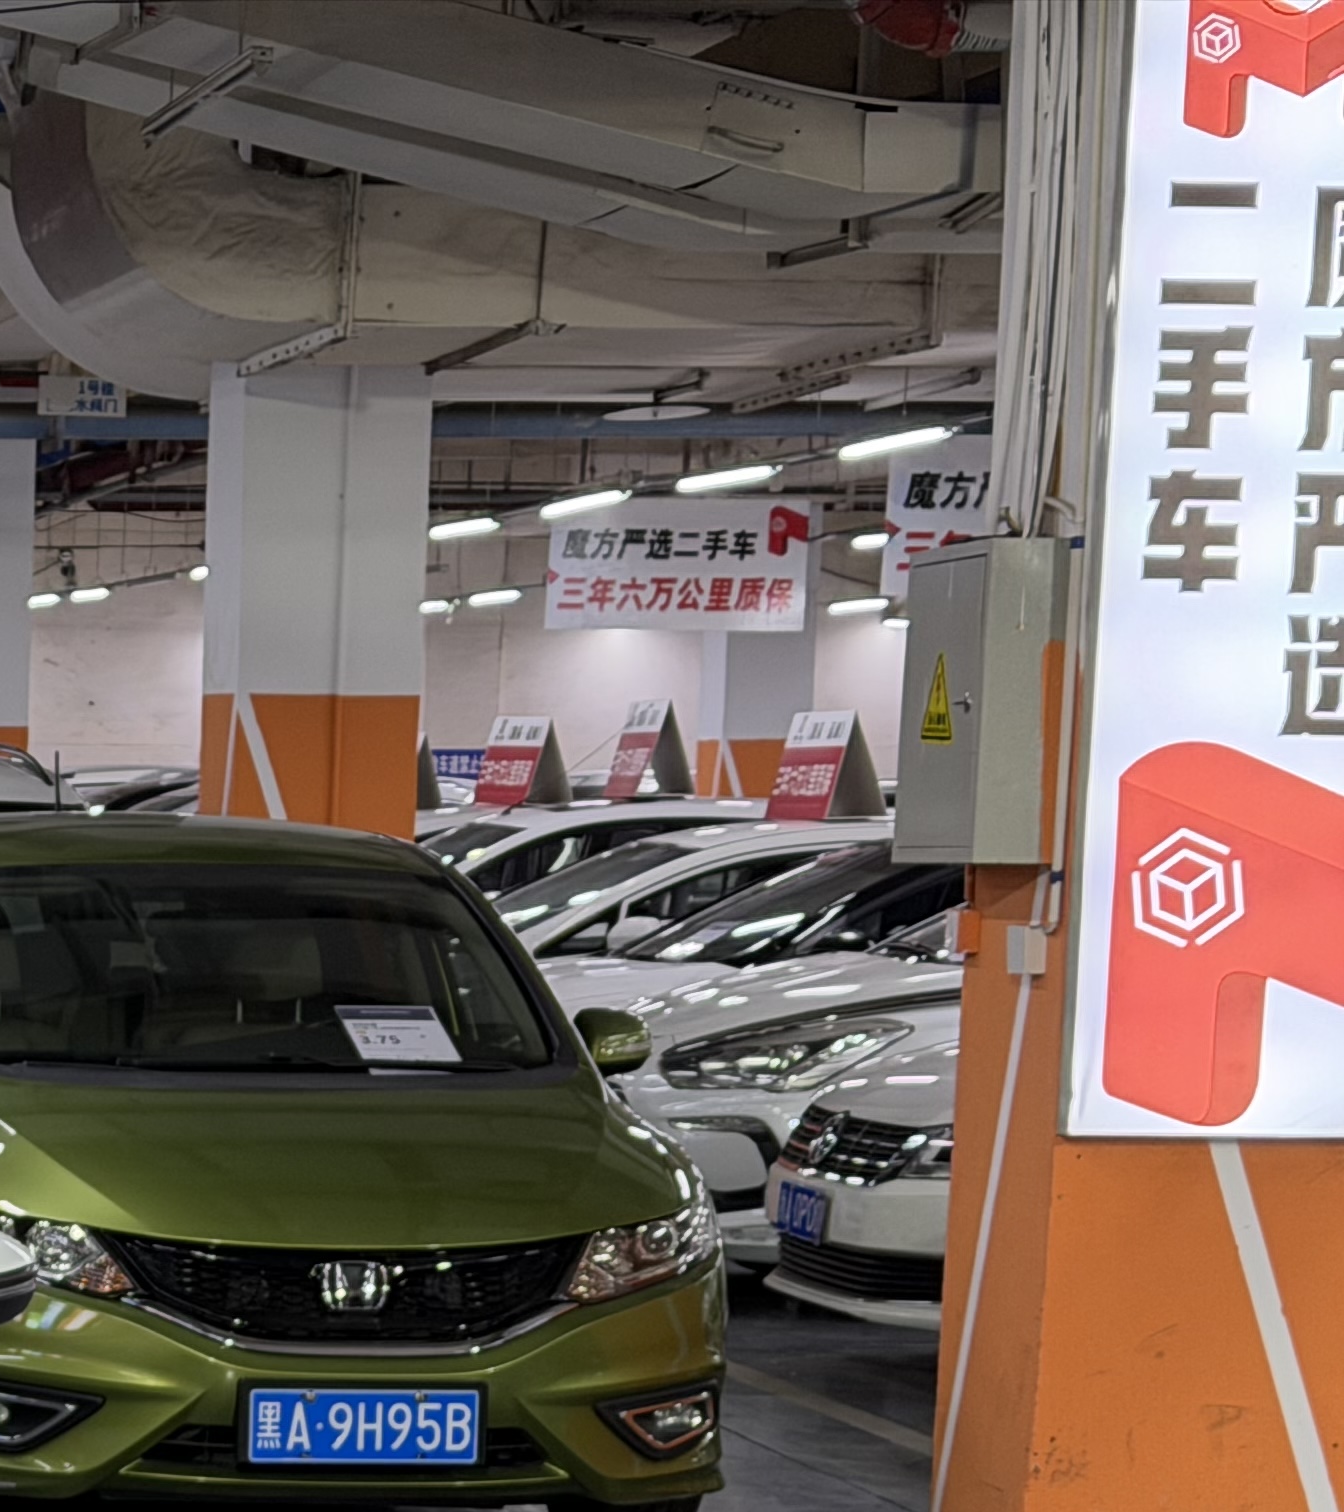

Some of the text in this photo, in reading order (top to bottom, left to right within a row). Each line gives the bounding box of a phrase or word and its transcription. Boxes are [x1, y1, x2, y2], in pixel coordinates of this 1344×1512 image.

[1141, 180, 1259, 592] 二手车
[561, 528, 759, 562] 魔方严选二手车
[556, 576, 795, 613] 三年六万公里质保
[257, 1401, 472, 1452] 黑A·9H95B
